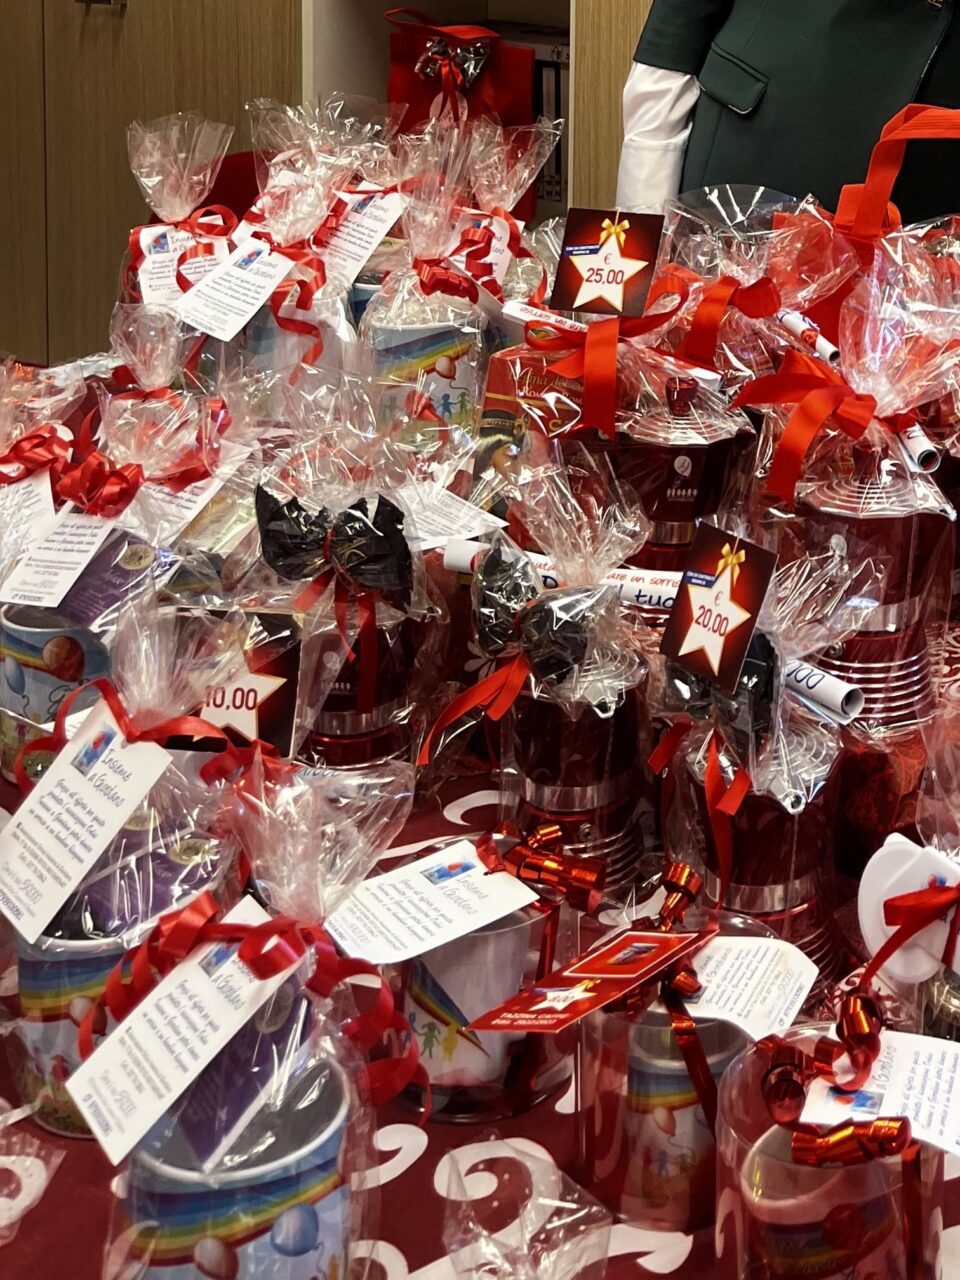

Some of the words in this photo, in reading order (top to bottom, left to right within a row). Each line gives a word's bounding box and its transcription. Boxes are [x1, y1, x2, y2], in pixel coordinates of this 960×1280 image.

[604, 253, 613, 265] €
[630, 575, 646, 583] un
[650, 577, 681, 588] sorris
[635, 588, 676, 608] tuo
[715, 591, 723, 606] €
[694, 605, 729, 637] 20,00
[101, 749, 134, 785] Insieme
[93, 774, 127, 810] Giordano
[874, 1044, 895, 1082] Giordano
